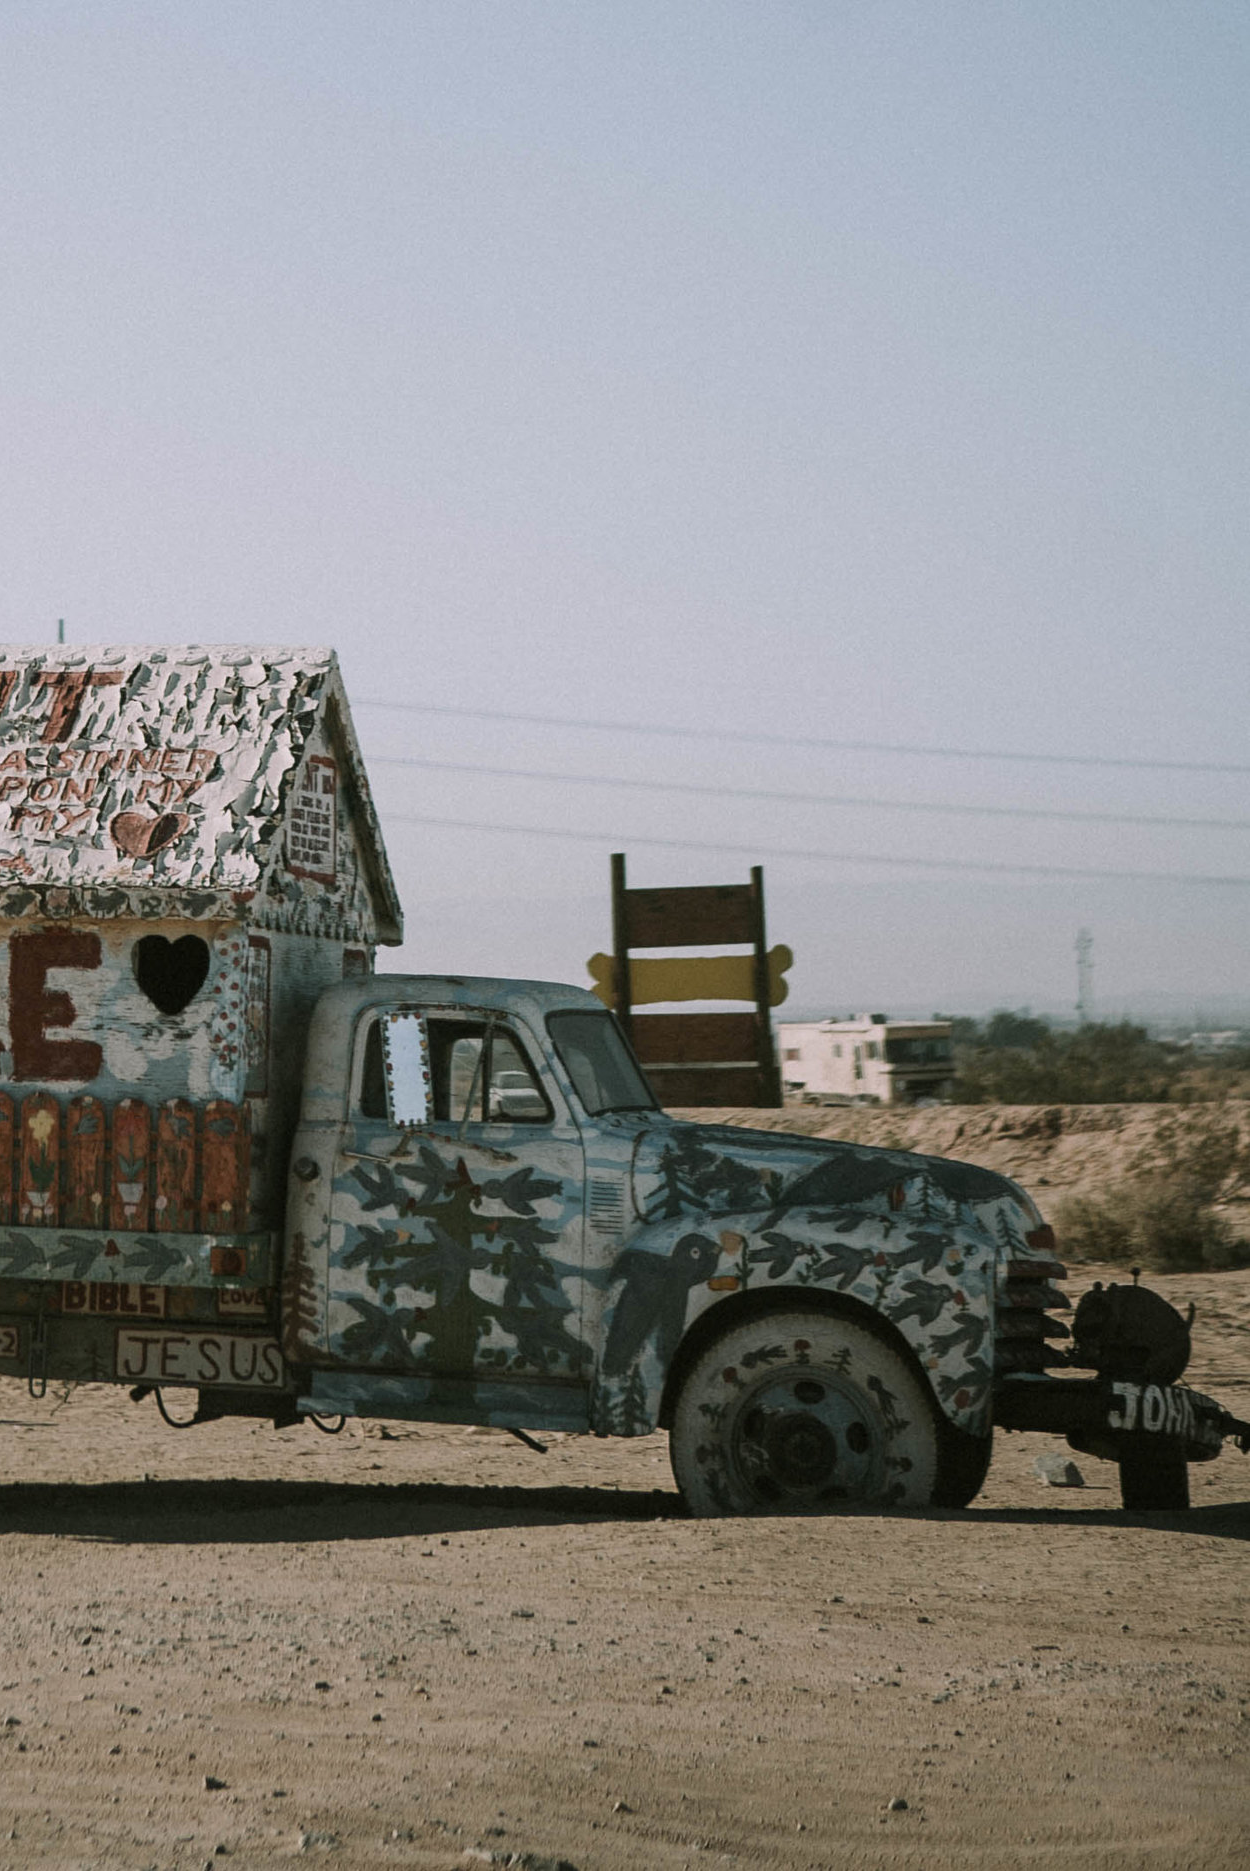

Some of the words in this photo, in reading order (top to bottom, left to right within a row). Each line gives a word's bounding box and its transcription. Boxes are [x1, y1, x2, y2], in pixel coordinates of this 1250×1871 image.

[0, 750, 27, 772] A
[57, 748, 218, 773] SINNER
[135, 779, 206, 803] MY
[8, 807, 92, 832] MY
[64, 1281, 161, 1314] BIBLE
[125, 1335, 284, 1385] JESUS
